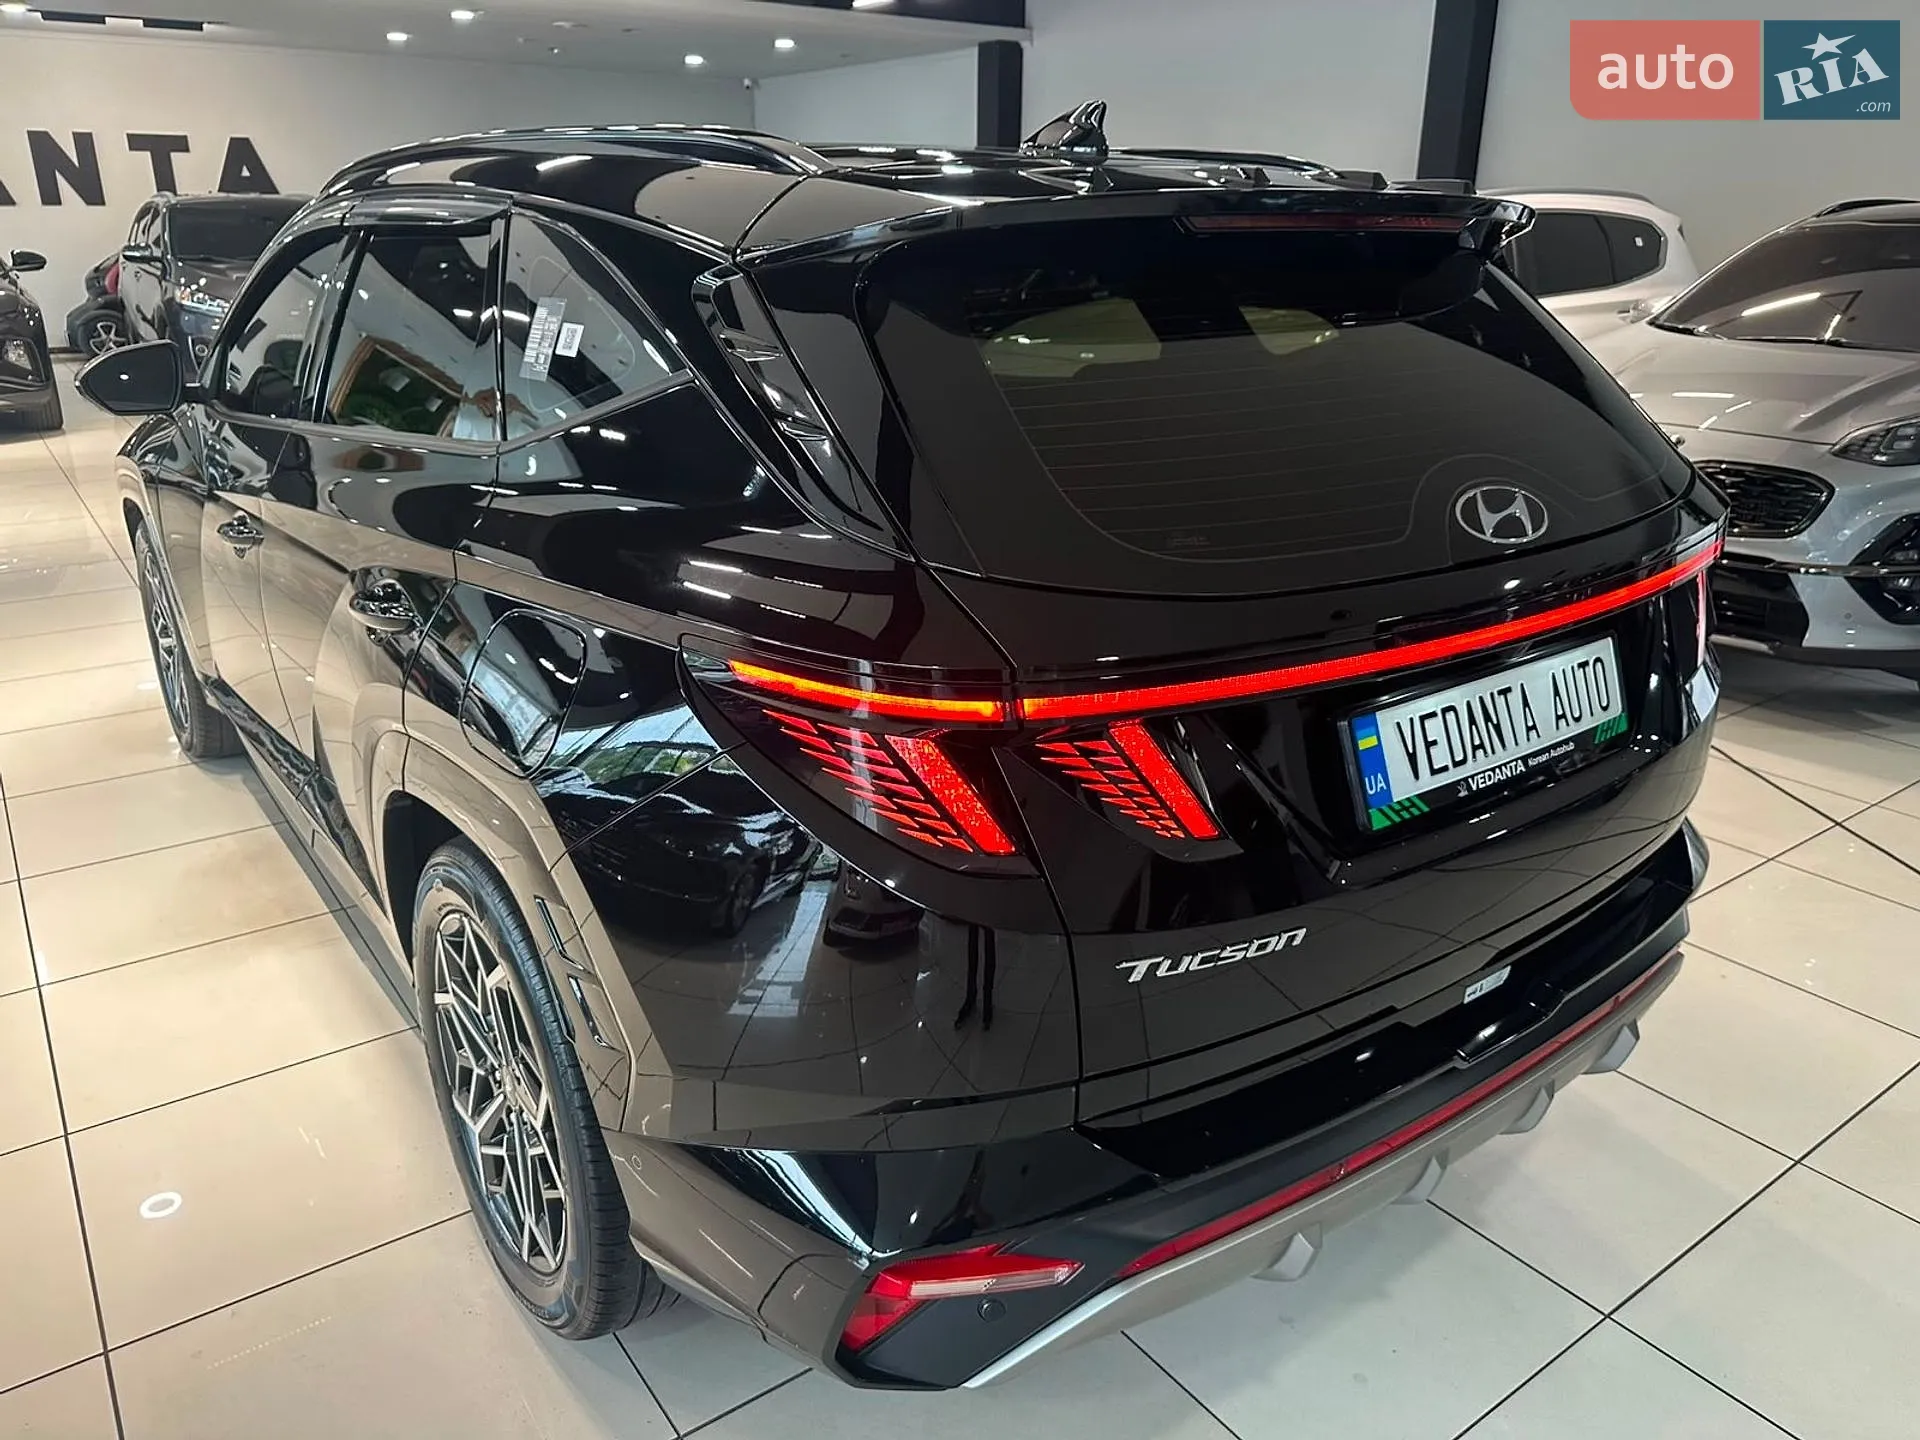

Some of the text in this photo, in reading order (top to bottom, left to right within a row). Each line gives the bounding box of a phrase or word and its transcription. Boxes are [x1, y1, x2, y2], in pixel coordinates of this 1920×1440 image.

[0, 129, 280, 206] NTA
[1396, 656, 1610, 782] VEDANTA AUTO
[1364, 772, 1387, 796] UA
[1468, 759, 1526, 791] VEDANTA
